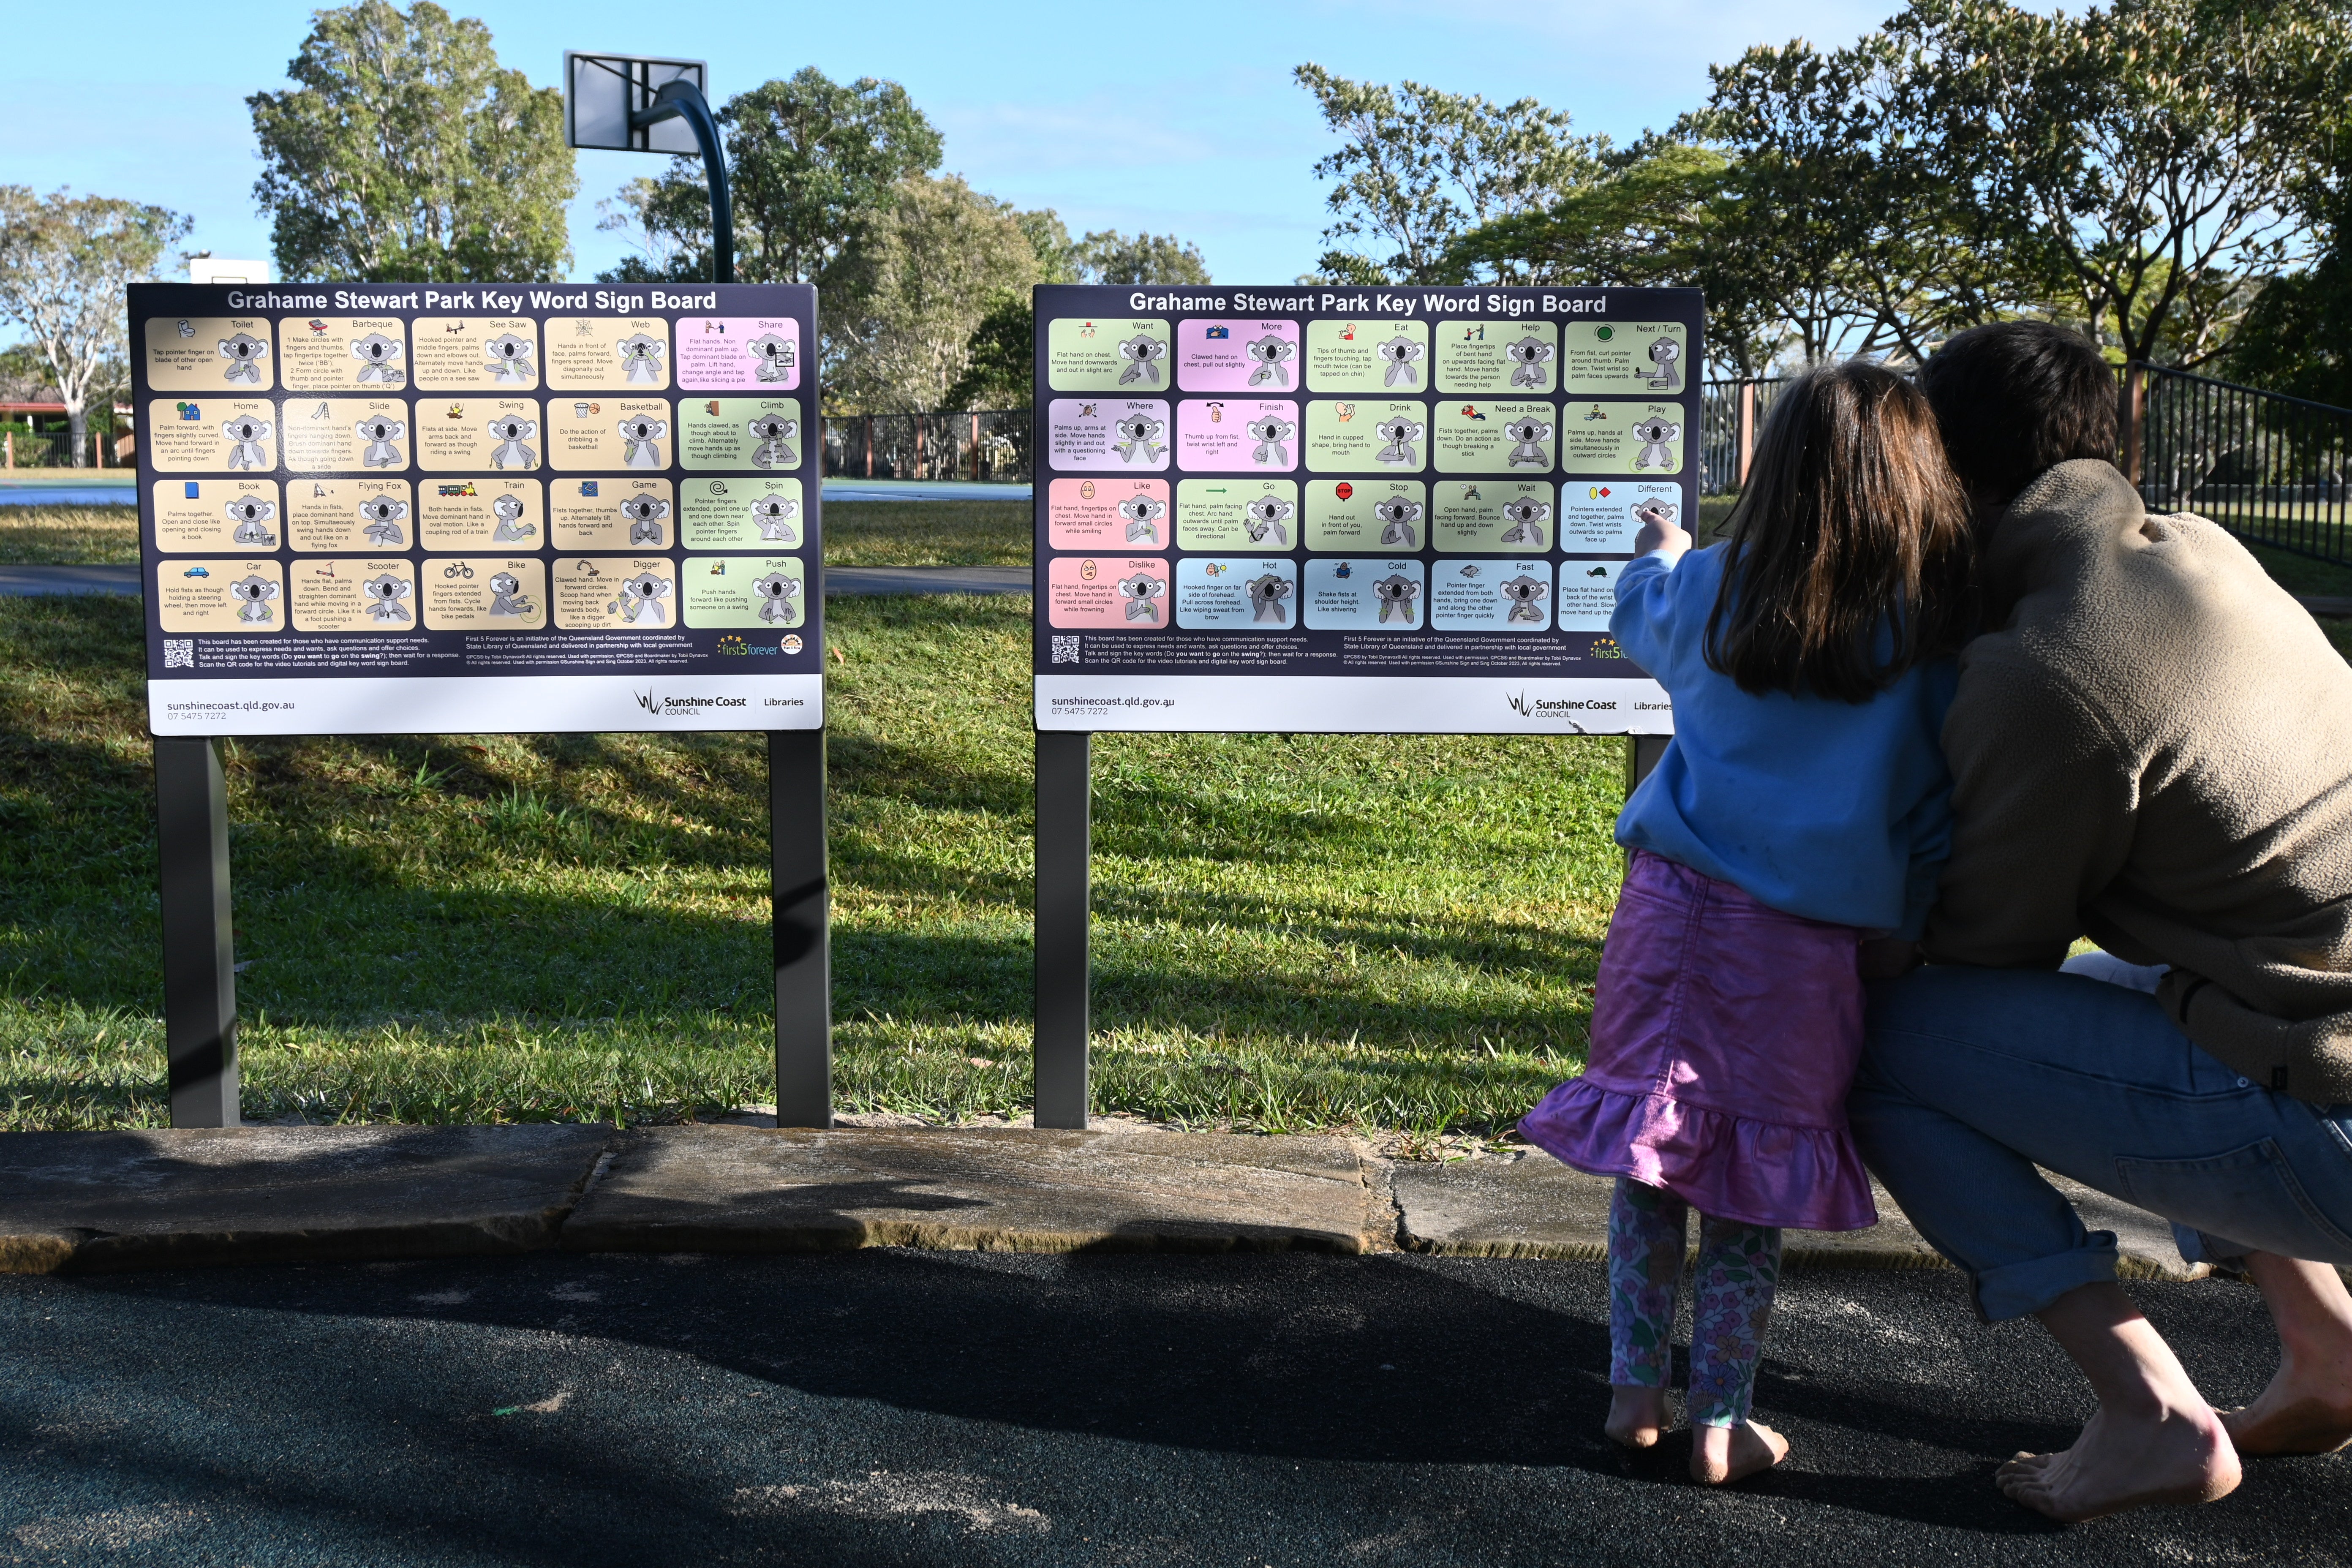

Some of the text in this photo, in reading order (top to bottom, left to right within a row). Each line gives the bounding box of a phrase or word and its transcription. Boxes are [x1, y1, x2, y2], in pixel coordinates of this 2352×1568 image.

[228, 291, 716, 313] Grahame Stewart Park Key Word Sign Board
[1130, 292, 1606, 316] Grahame Stewart Park Key Word Sign Board
[353, 320, 392, 329] Barbeque
[1522, 324, 1540, 332] Help
[499, 401, 524, 410] Swing
[1648, 405, 1666, 414] Play
[359, 482, 383, 491] Flying
[765, 482, 783, 490] Spin
[1390, 483, 1408, 492] Stop
[634, 561, 660, 569] Digger
[167, 701, 294, 712] sunshinecoast.qld.gov.au
[665, 697, 746, 707] Sunshine Coast
[1052, 697, 1174, 708] sunshinecoast.qld.gov.au
[1536, 700, 1617, 710] Sunshine Coast
[1634, 702, 1672, 710] Libraries
